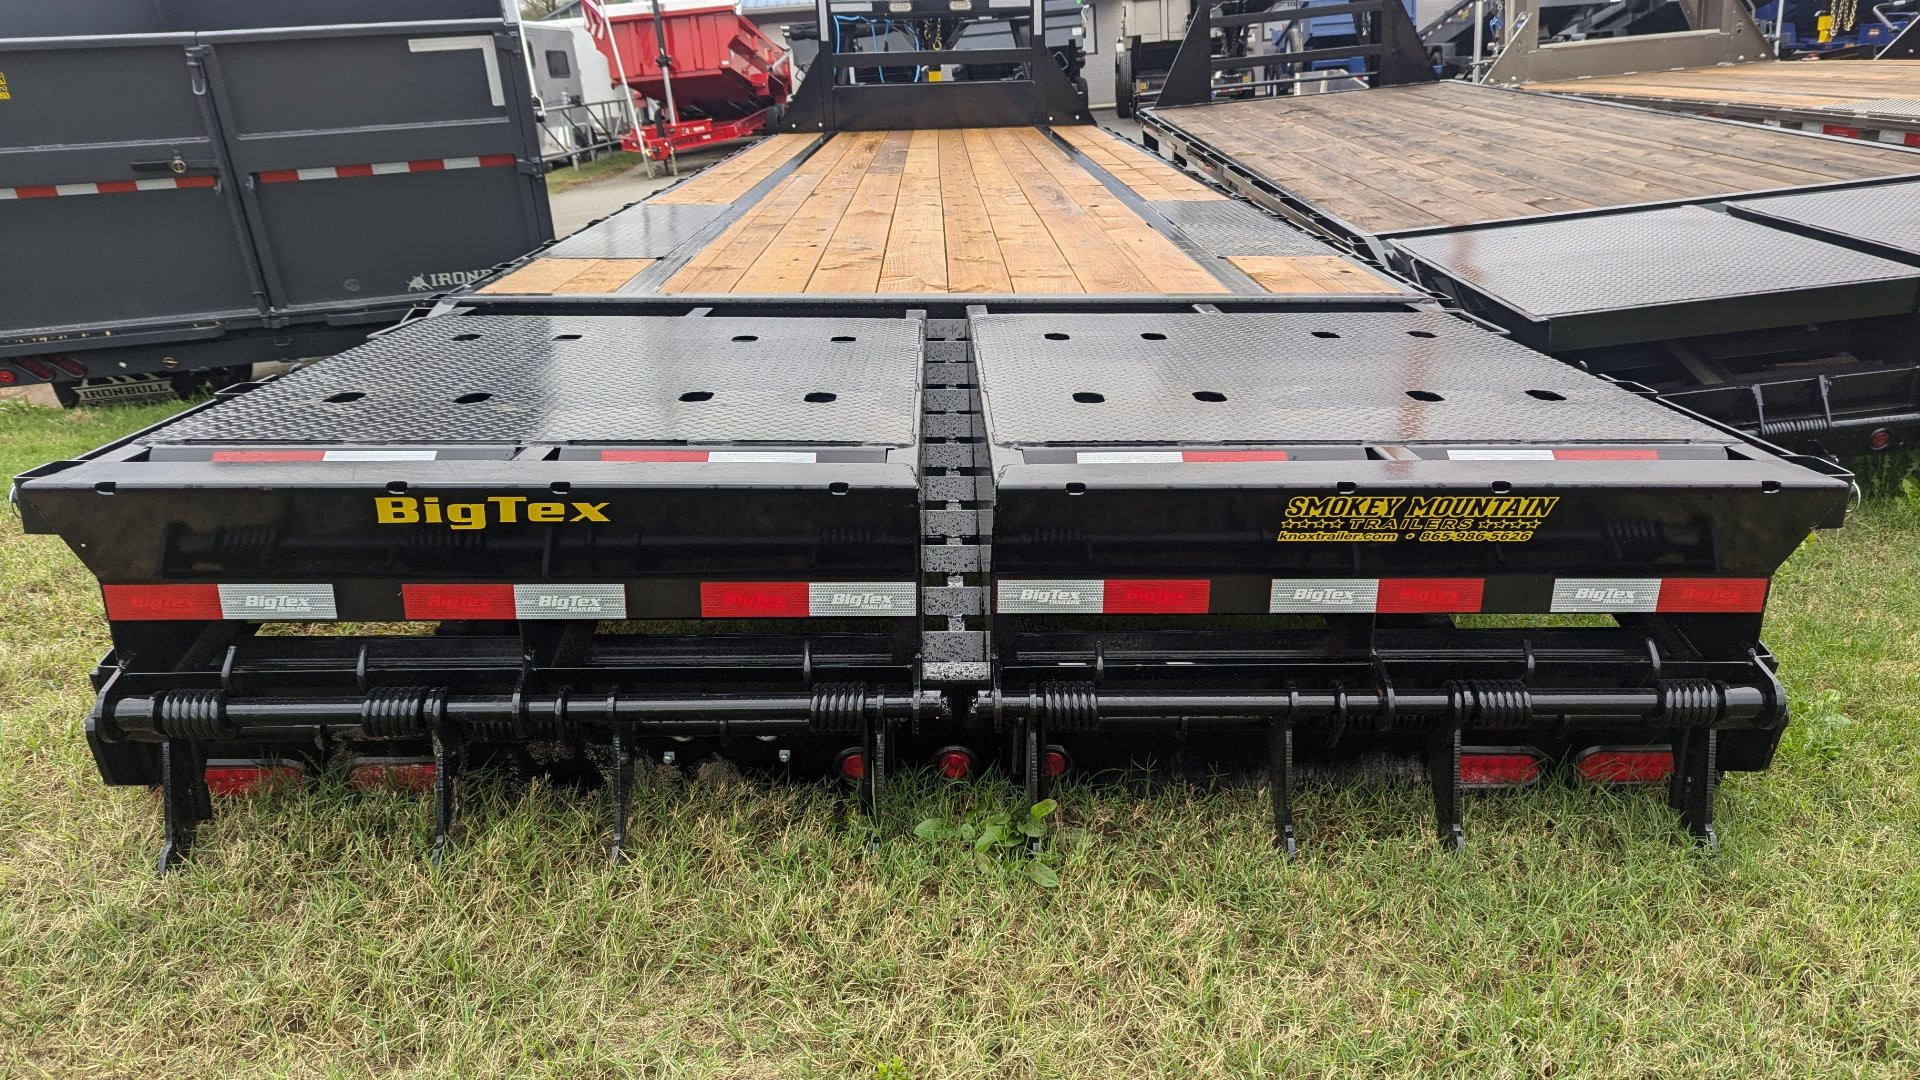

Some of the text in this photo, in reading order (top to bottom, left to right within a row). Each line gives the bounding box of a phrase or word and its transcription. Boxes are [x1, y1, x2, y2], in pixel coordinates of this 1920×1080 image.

[83, 384, 168, 399] IRONBULL
[374, 496, 611, 530] BigTex
[1285, 496, 1560, 518] SMOKEY MOUNTAIN
[1349, 518, 1474, 530] TRAILERS
[1419, 530, 1533, 542] 865-986-5626
[245, 595, 310, 609] BigTex
[538, 595, 601, 609] BigTex
[832, 593, 893, 607] BigTex
[1020, 589, 1082, 603] BigTex
[1293, 588, 1354, 602] BigTex
[1575, 588, 1636, 602] BigTex
